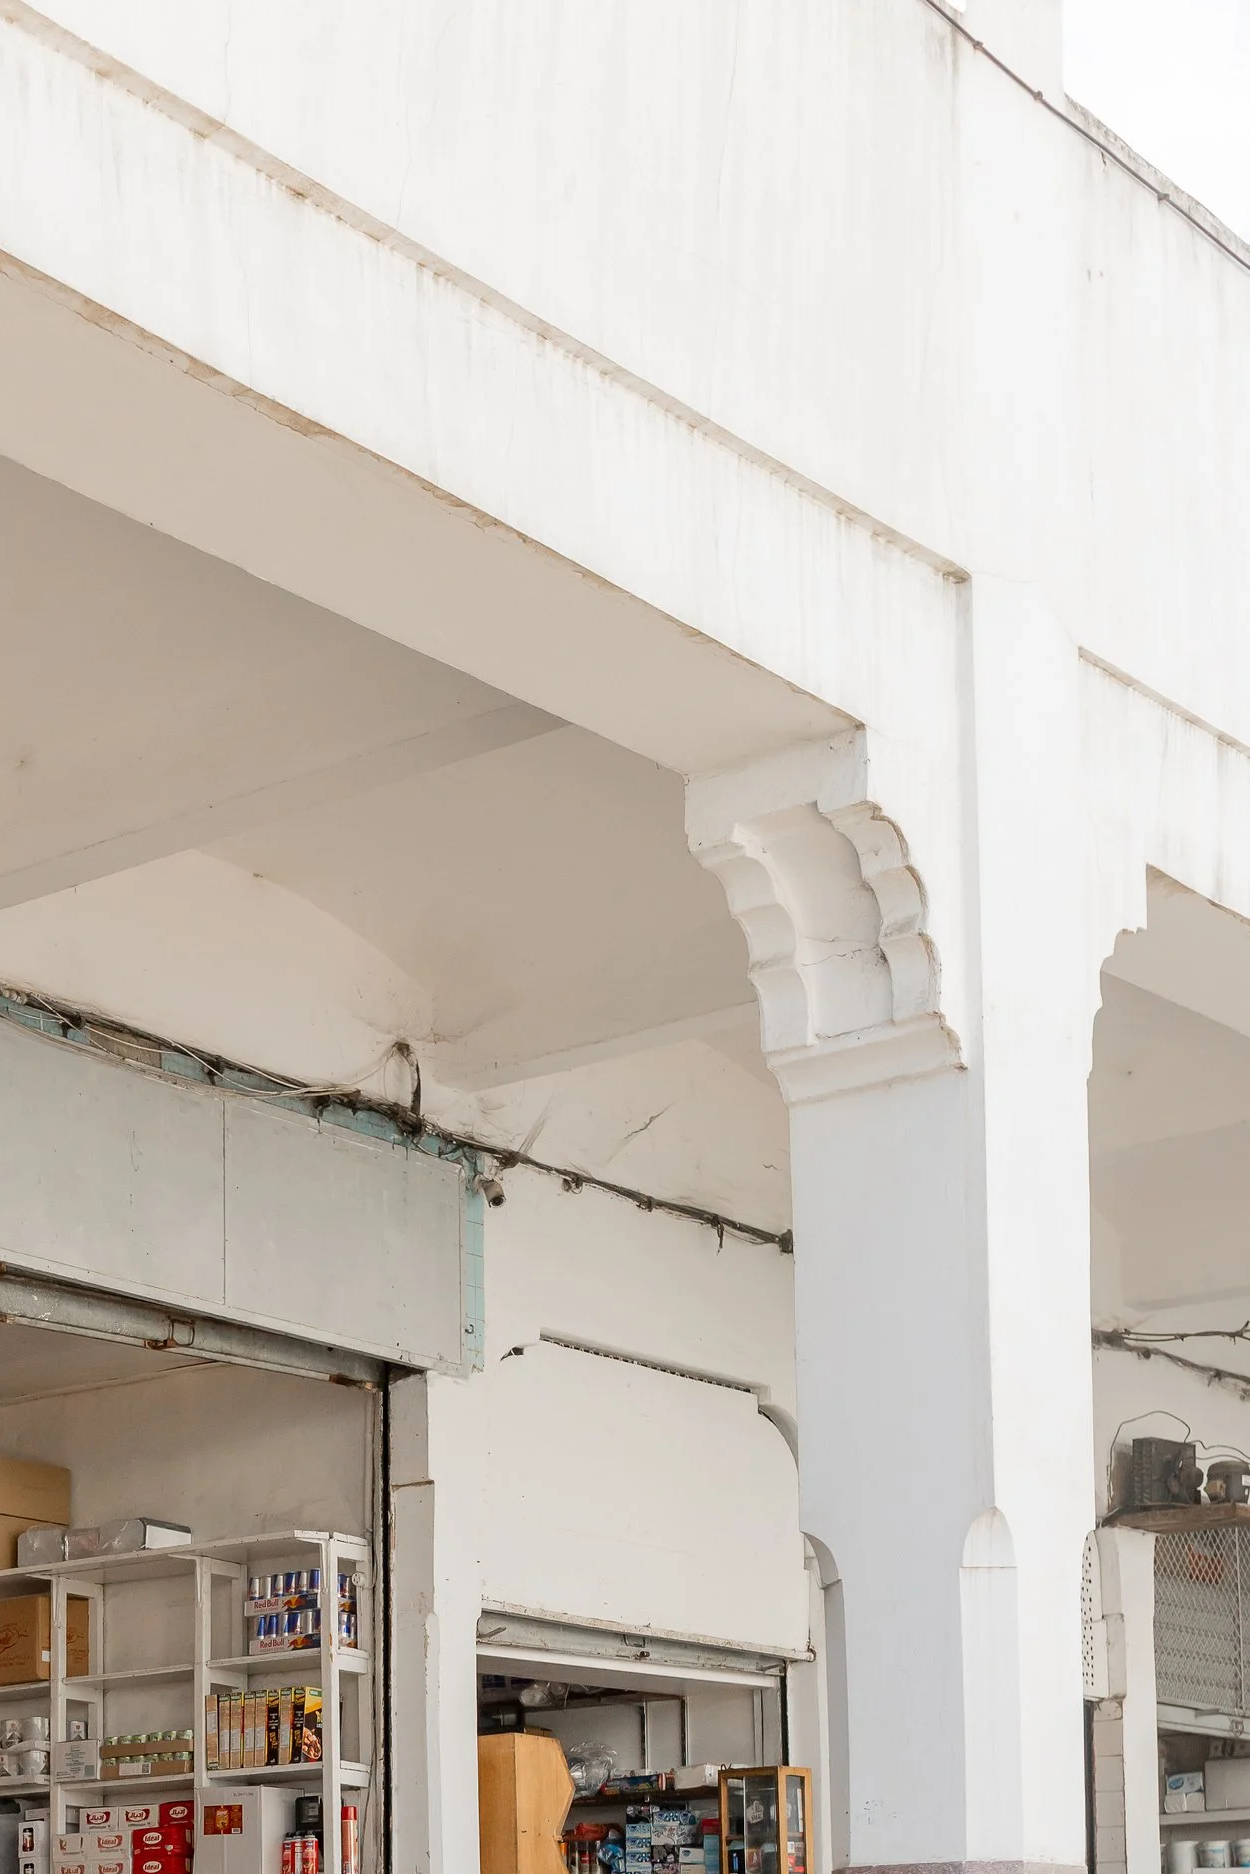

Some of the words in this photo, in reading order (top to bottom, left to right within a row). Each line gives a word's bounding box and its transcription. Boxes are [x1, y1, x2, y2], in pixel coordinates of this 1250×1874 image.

[254, 1601, 266, 1609] Red
[267, 1598, 278, 1607] Bull
[260, 1641, 272, 1649] Red
[273, 1639, 284, 1647] Bull
